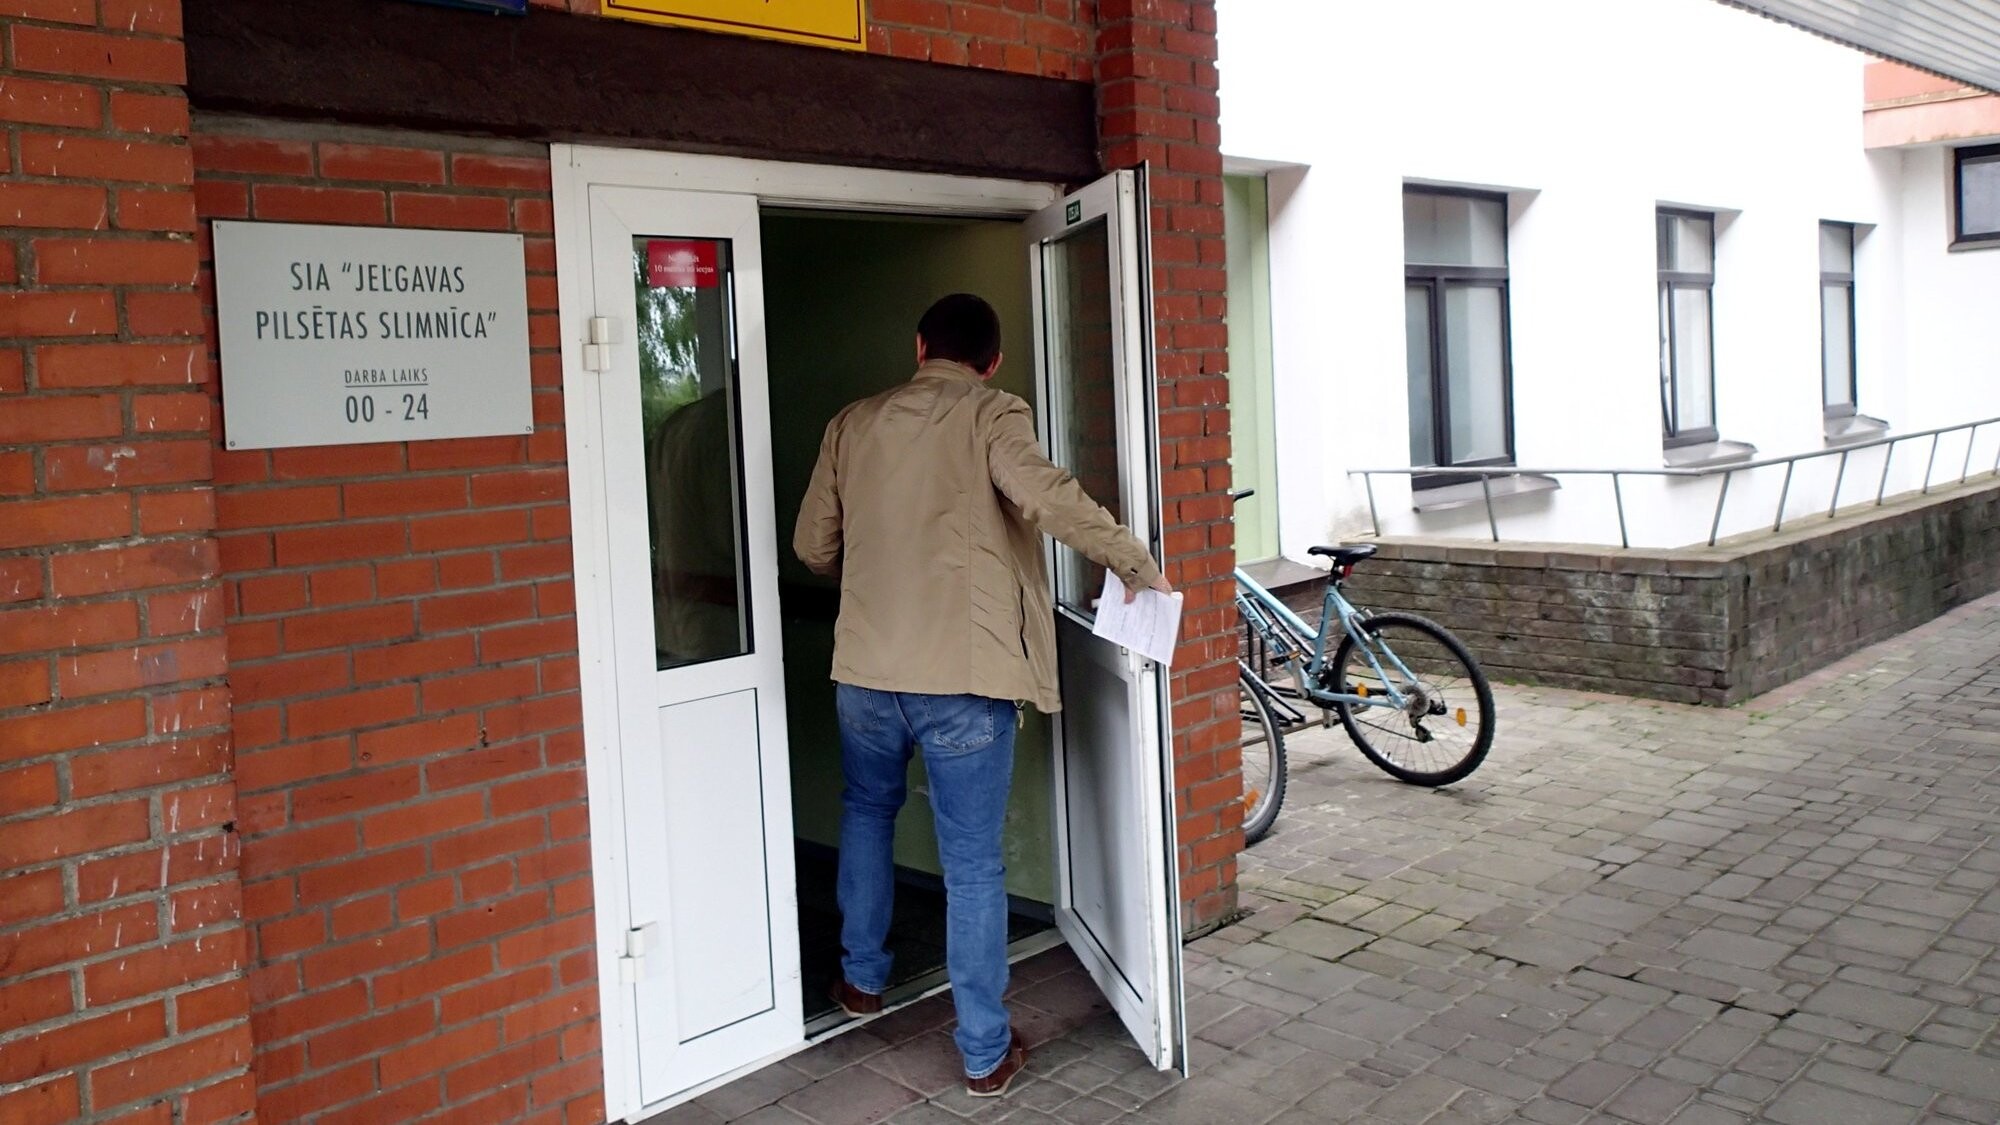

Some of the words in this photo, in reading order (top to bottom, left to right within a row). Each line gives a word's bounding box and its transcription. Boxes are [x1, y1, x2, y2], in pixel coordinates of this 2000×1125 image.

[290, 262, 331, 291] SIA
[255, 305, 369, 339] PILSĒTAS
[344, 369, 387, 384] DARBA
[392, 367, 429, 383] LAIKS
[345, 395, 375, 423] 00
[402, 393, 430, 420] 24
